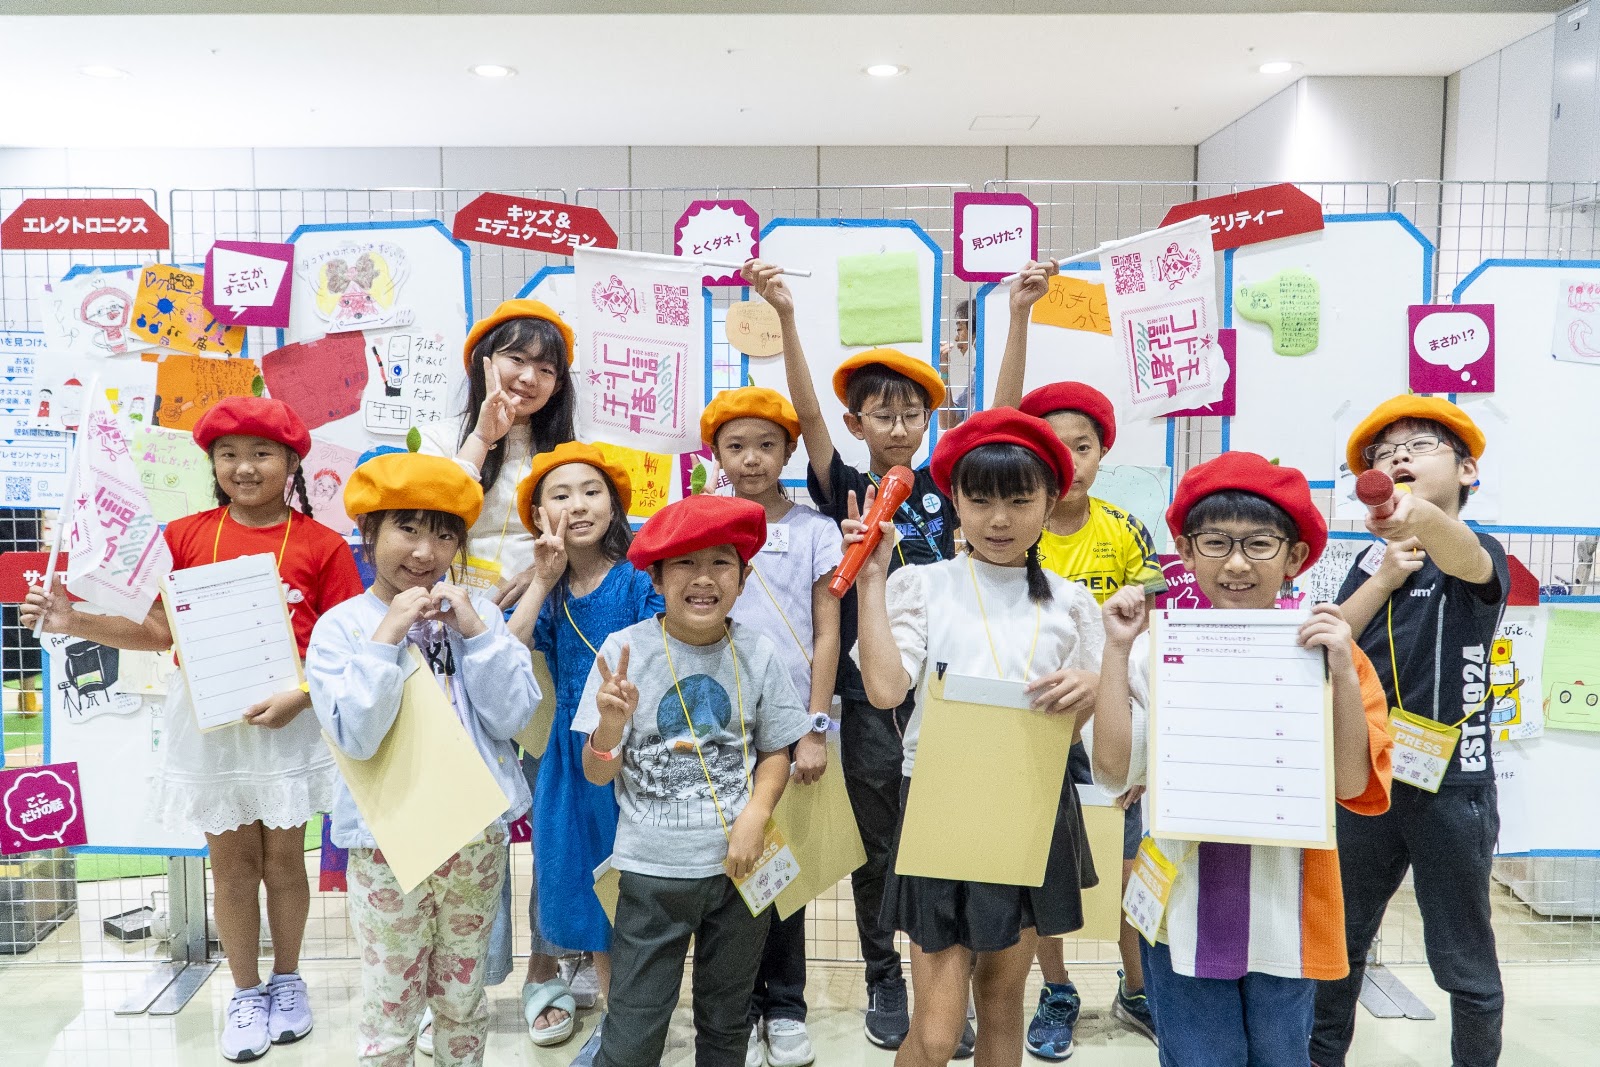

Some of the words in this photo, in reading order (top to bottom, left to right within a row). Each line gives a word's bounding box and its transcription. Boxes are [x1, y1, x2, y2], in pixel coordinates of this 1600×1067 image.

[22, 216, 149, 234] エレクトロニクス
[475, 217, 598, 248] エデュケーション
[692, 232, 742, 255] とくダネ！
[972, 227, 1024, 251] 見つけた？
[228, 267, 264, 283] ここが
[223, 278, 269, 297] すごい！
[1148, 324, 1175, 380] 記者
[1170, 309, 1200, 384] コドモ
[1428, 328, 1476, 352] まさか!?
[1137, 322, 1151, 389] Hello!
[0, 451, 60, 460] レゼントゲット!
[1461, 643, 1487, 772] EST.1924
[1394, 731, 1443, 756] PRESS
[20, 797, 65, 825] だけの話
[26, 792, 49, 809] ここ
[631, 799, 704, 827] EARTH
